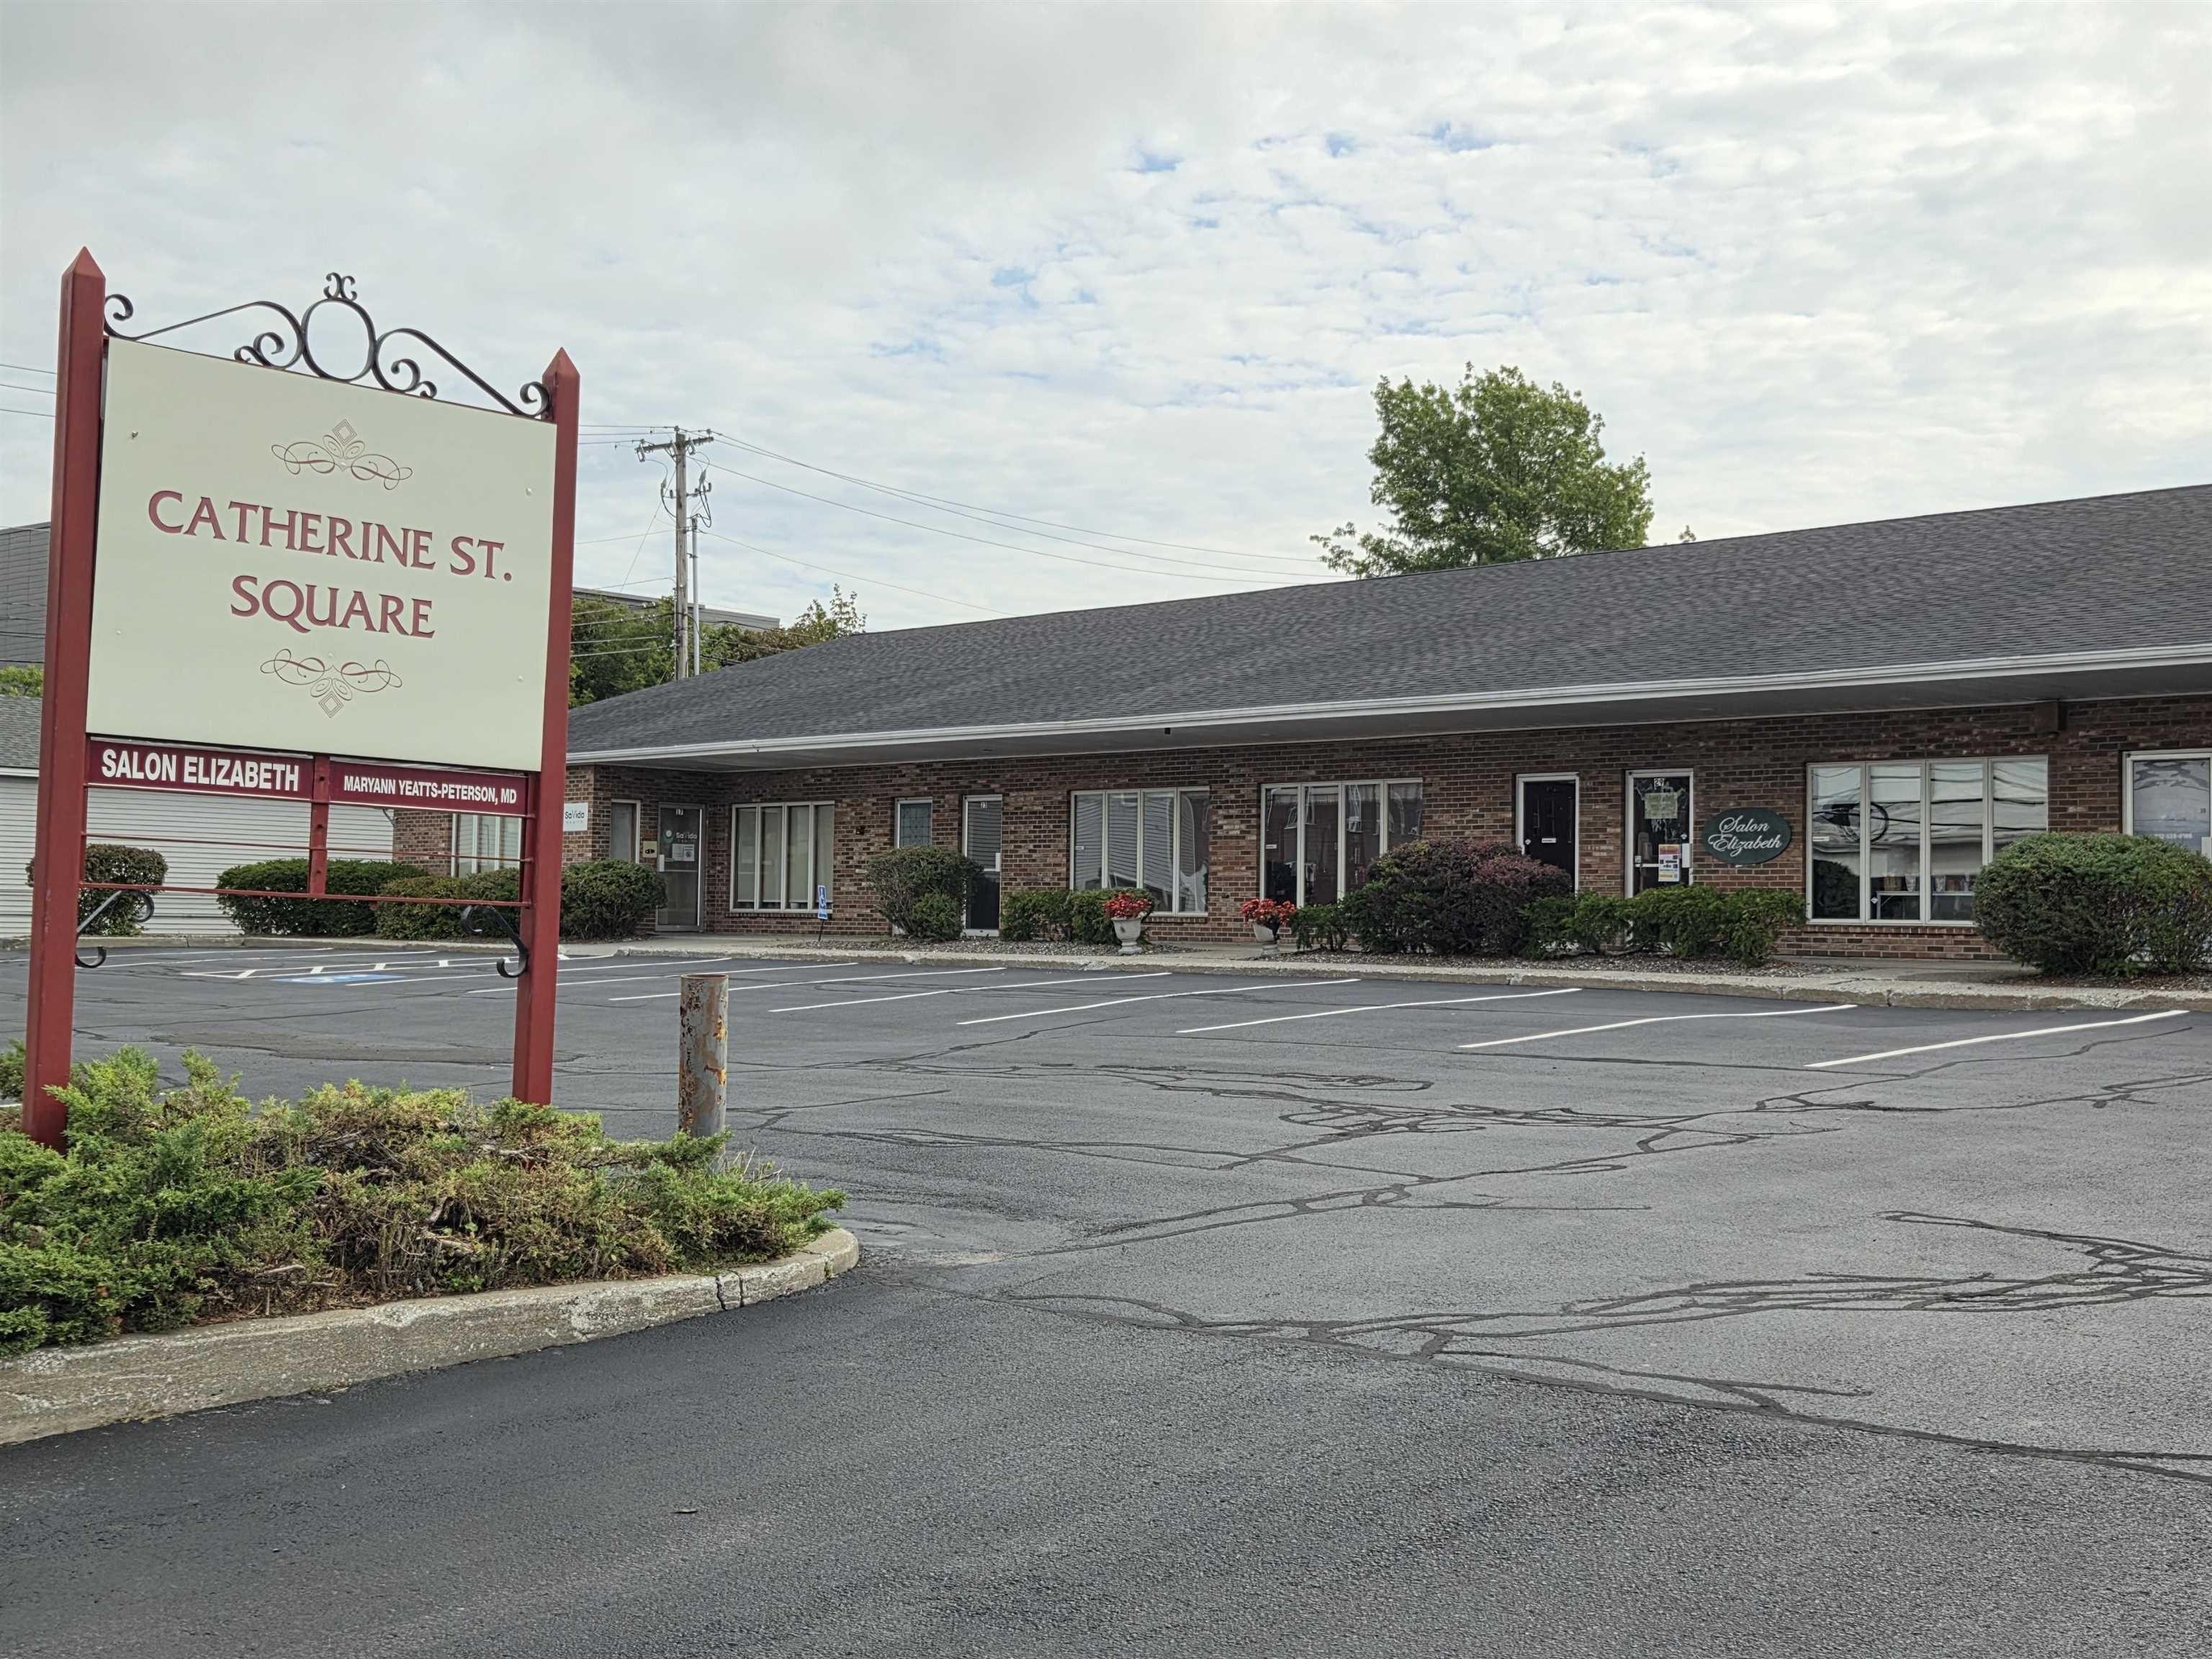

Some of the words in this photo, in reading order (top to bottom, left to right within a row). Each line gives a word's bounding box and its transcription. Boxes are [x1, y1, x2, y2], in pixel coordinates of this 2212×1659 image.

[148, 490, 436, 570] CATHERINE
[449, 536, 512, 582] ST.
[230, 575, 435, 639] SQUARE
[102, 749, 176, 782] SALON
[184, 756, 300, 791] ELIZABETH
[344, 775, 396, 794] MARYANN
[398, 780, 498, 805] YEATTS-PETERSON,
[500, 788, 516, 804] MD
[1719, 815, 1770, 833] Salon
[1707, 834, 1782, 857] Elizabeth
